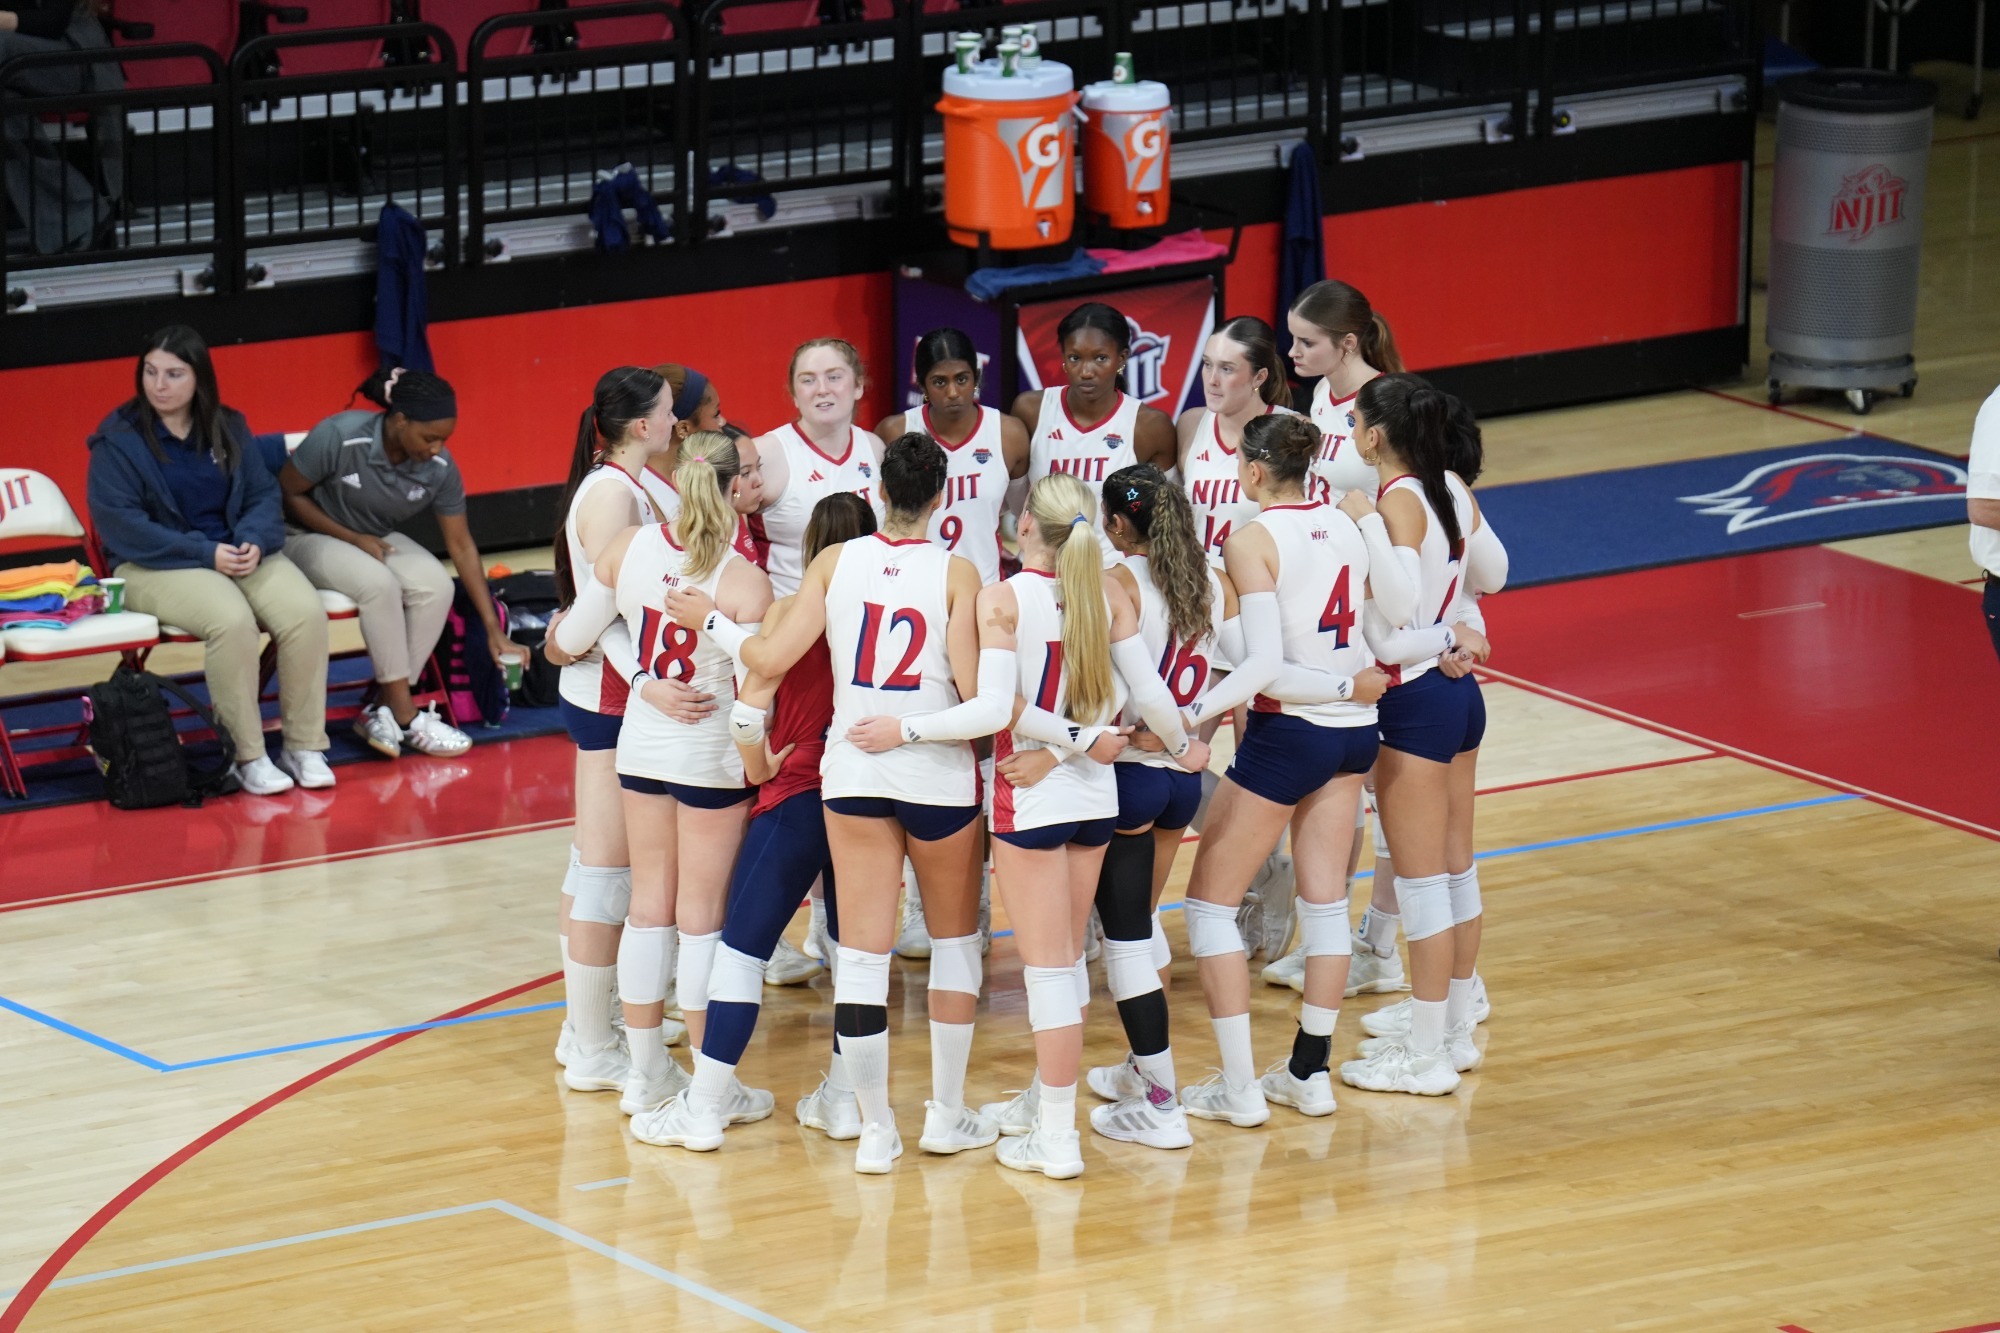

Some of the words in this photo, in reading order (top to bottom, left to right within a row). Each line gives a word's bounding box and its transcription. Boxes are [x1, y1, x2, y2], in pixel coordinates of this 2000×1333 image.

[1834, 188, 1905, 235] NJIT
[945, 473, 981, 510] JIT
[1192, 479, 1241, 511] NJIT
[940, 515, 963, 552] 9
[1204, 515, 1231, 557] 14
[1318, 565, 1356, 650] 4
[637, 605, 698, 684] 18
[851, 601, 927, 692] 12
[1158, 624, 1208, 707] 16
[1035, 641, 1062, 713] 1
